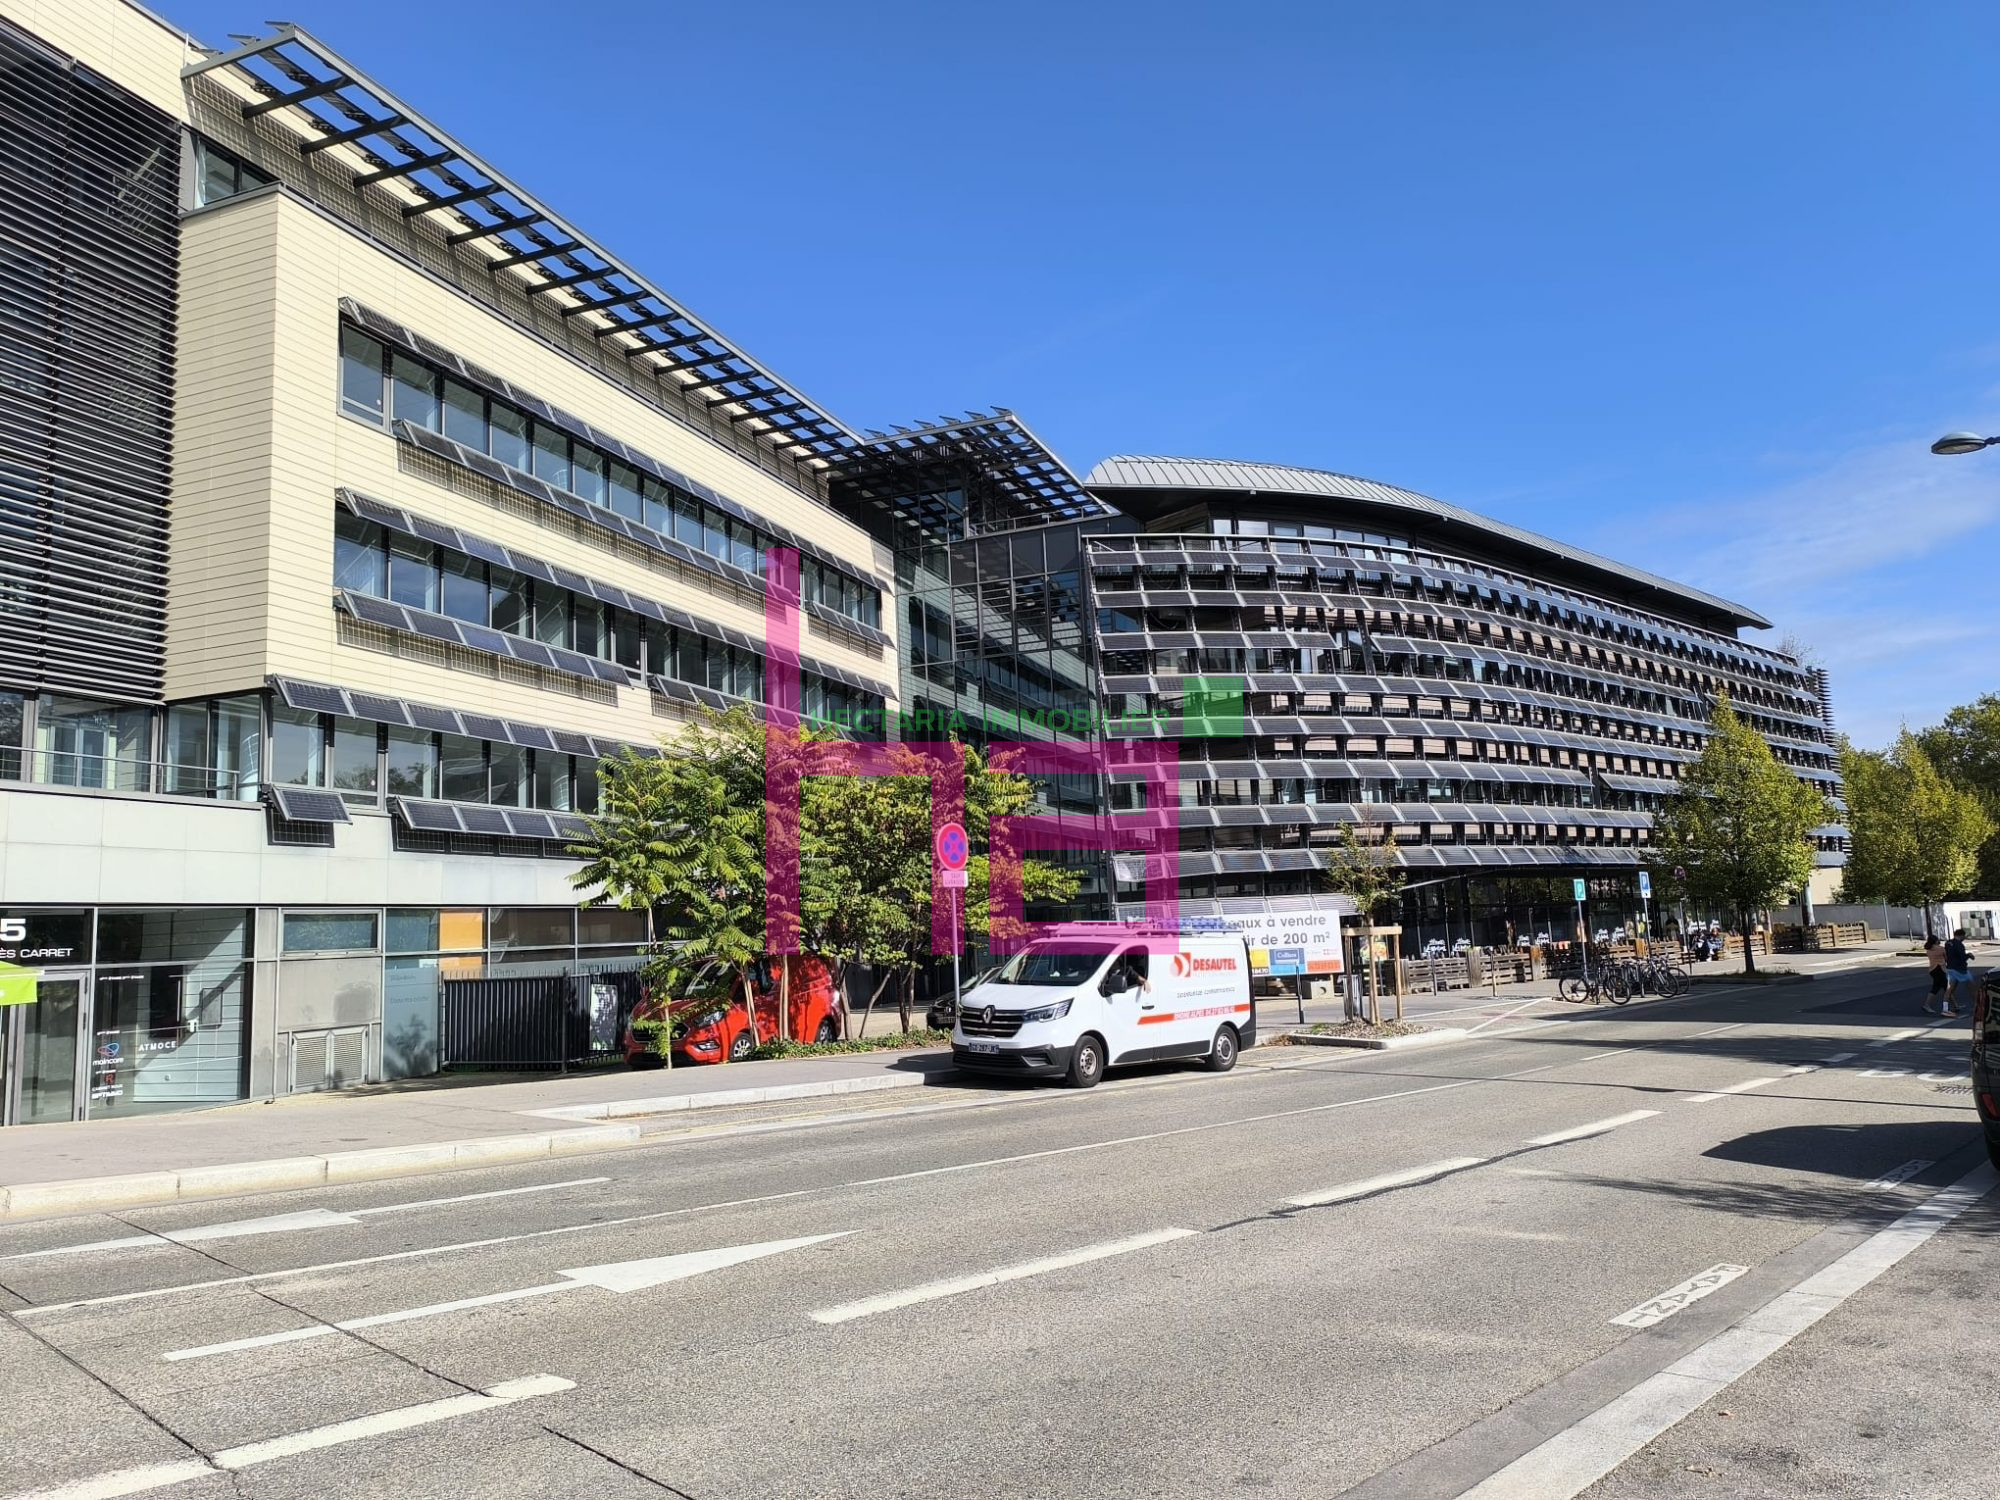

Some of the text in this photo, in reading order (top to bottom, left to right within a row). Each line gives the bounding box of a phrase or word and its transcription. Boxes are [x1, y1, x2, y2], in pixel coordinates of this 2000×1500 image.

[1266, 915, 1276, 928] à
[1280, 914, 1327, 927] vendre
[0, 918, 27, 941] 5
[1261, 934, 1279, 945] de
[1284, 933, 1308, 945] 200
[20, 948, 75, 959] CARRET
[1192, 958, 1237, 972] DESAUTEL
[138, 1041, 177, 1052] ATMOCE
[1629, 1265, 1743, 1323] PAYANT
